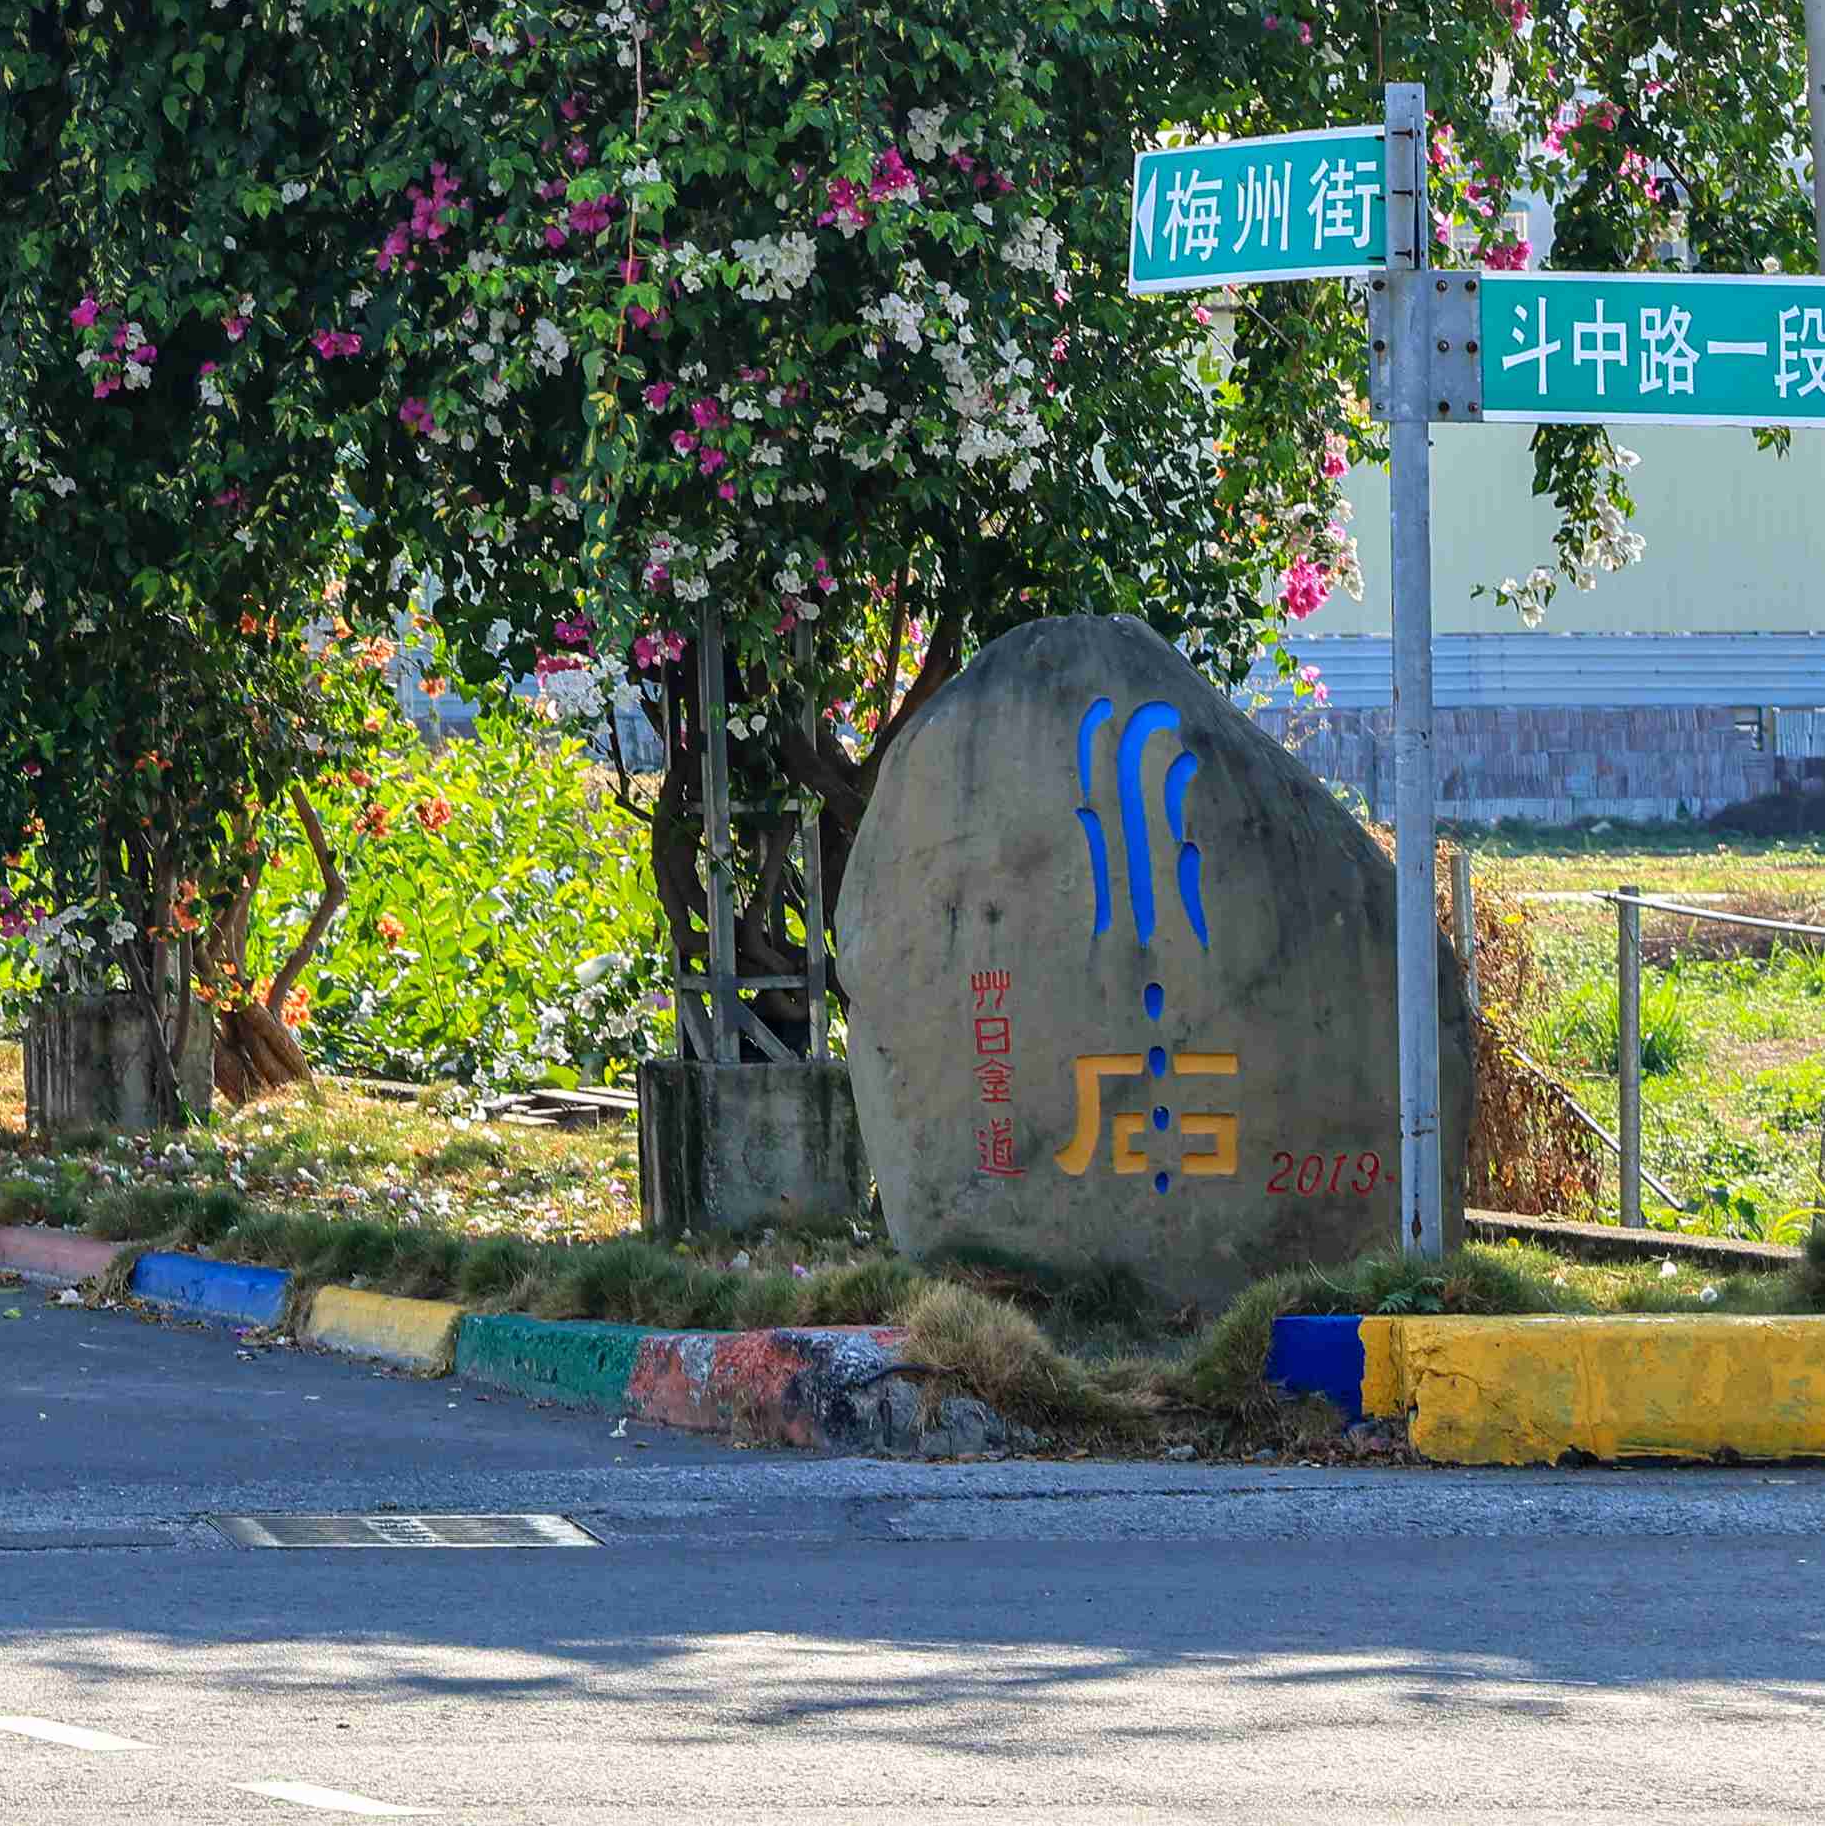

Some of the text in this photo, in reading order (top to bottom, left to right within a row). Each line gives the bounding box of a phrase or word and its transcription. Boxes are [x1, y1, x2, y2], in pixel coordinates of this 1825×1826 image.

[1162, 158, 1380, 262] 梅州街
[1502, 296, 1825, 398] 斗中路一段
